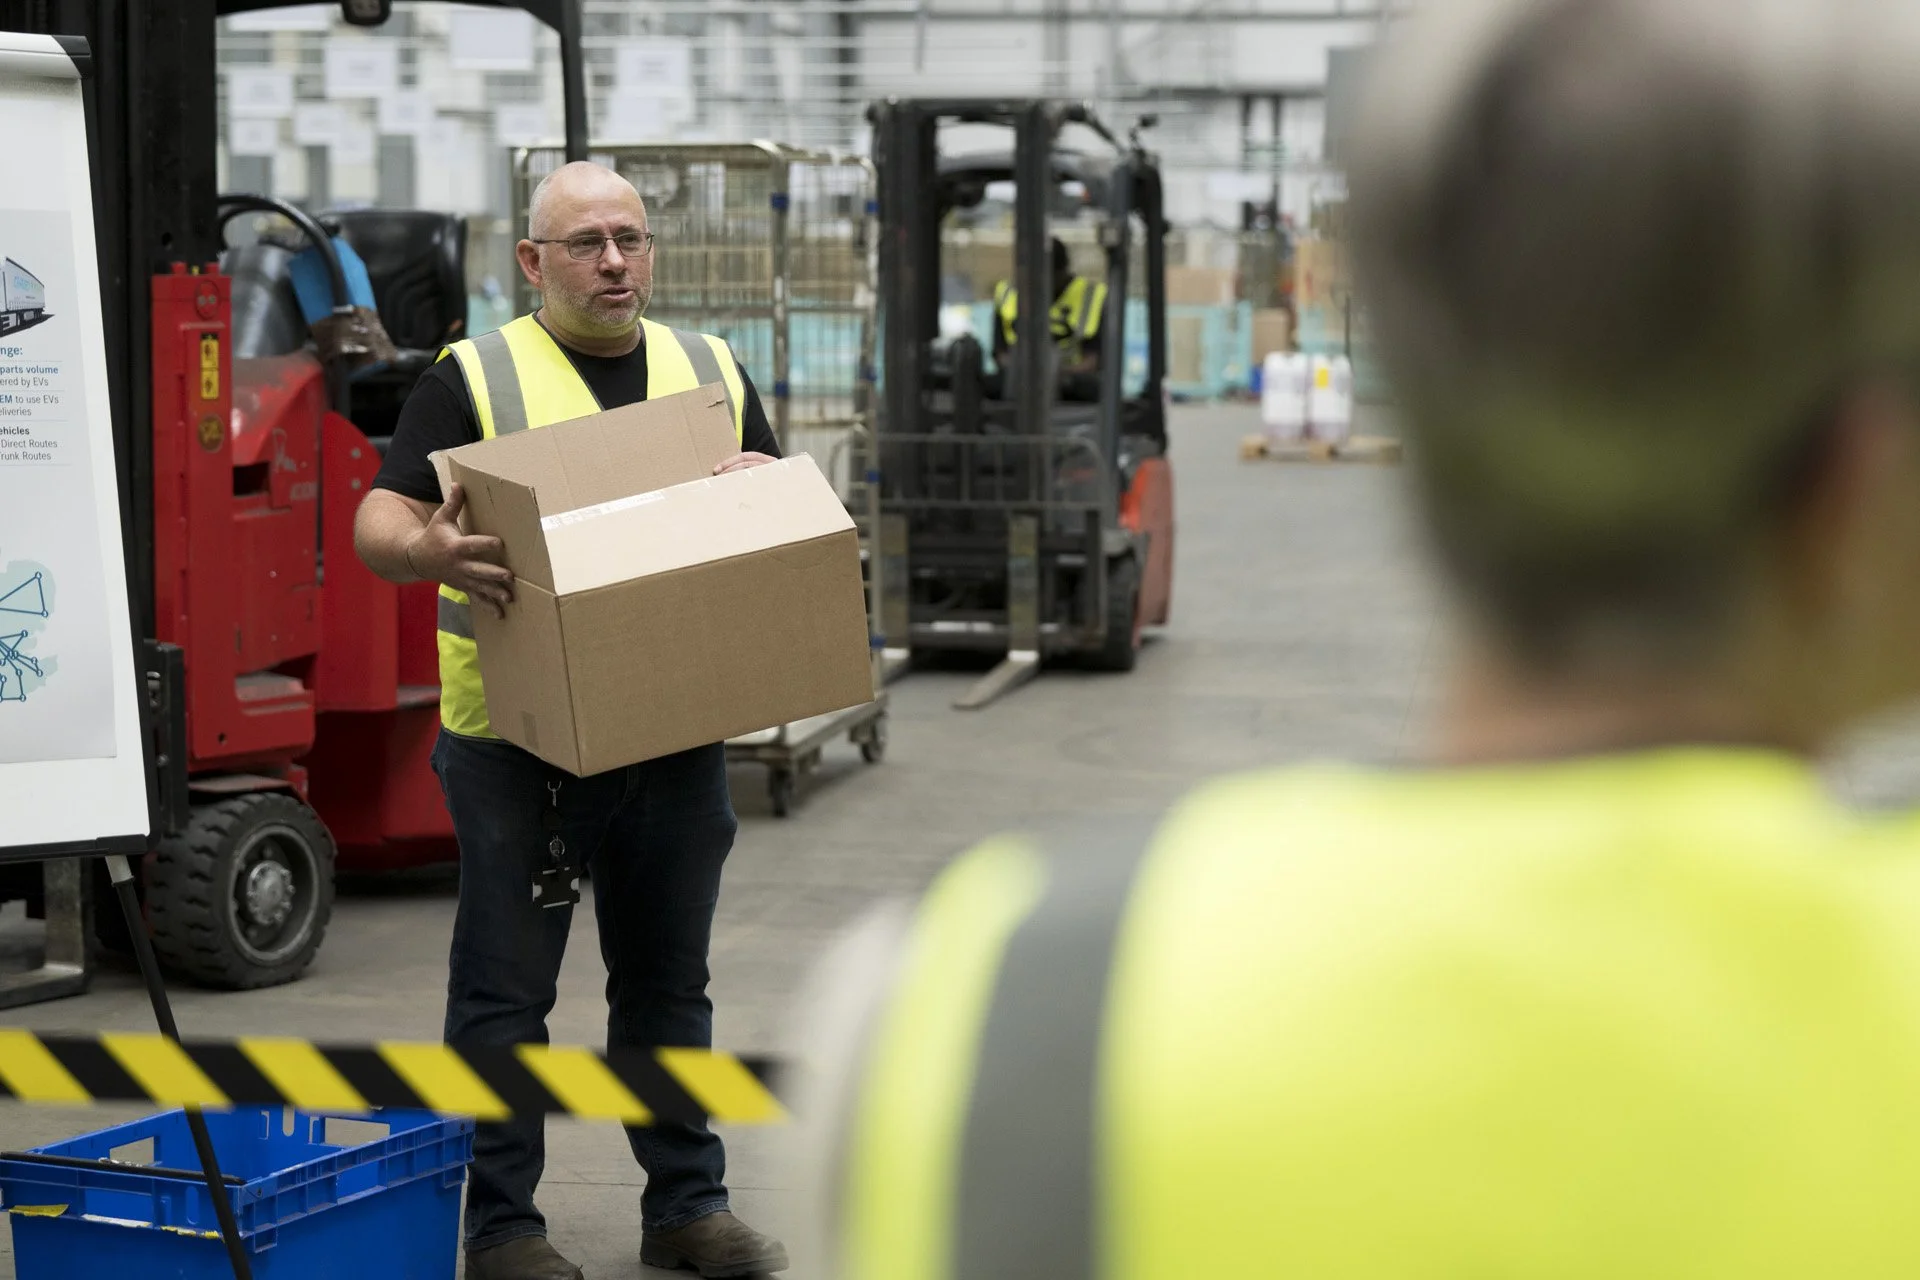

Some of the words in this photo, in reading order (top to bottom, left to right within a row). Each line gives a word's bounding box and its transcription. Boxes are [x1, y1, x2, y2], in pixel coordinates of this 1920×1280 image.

[0, 366, 23, 375] parts
[26, 365, 59, 374] volume
[0, 377, 19, 386] ered
[21, 377, 31, 388] by
[33, 377, 49, 386] EVs
[0, 394, 13, 404] EM
[15, 396, 24, 404] to
[26, 396, 41, 404] use
[43, 394, 59, 404] EVs
[1, 439, 26, 448] Direct
[29, 439, 58, 448] Routes
[0, 451, 20, 460] runk
[22, 451, 52, 460] Routes
